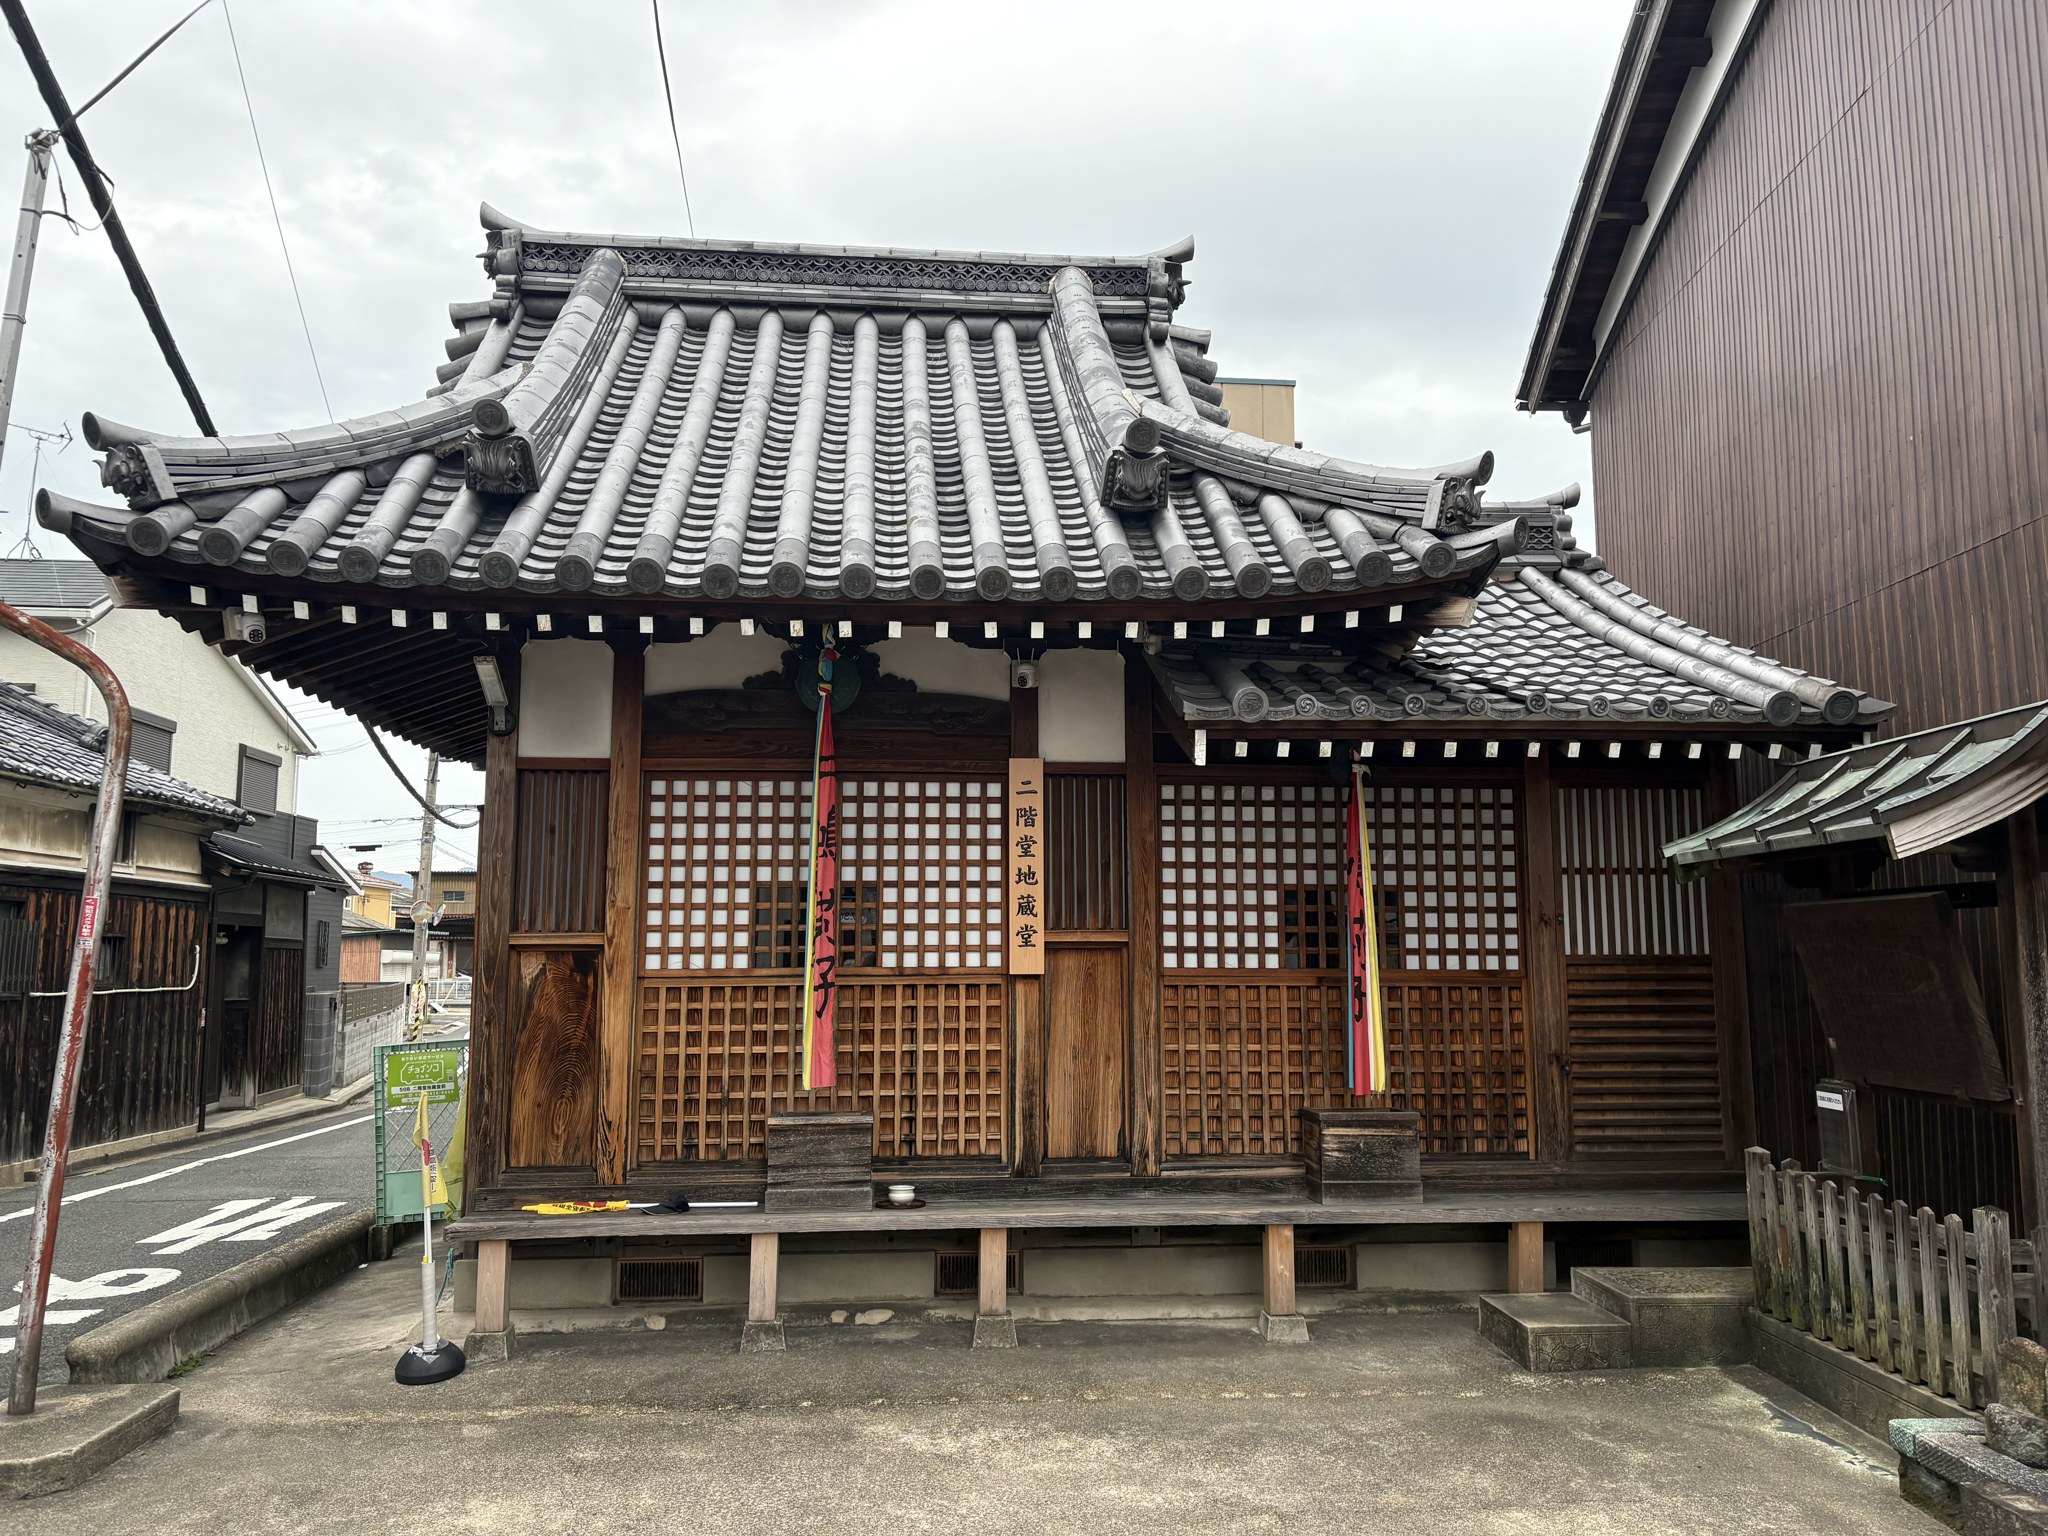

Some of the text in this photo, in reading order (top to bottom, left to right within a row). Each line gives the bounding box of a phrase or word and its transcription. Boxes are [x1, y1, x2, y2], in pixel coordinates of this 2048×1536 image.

[1014, 779, 1039, 948] 二階堂地蔵堂
[407, 1063, 440, 1074] チョイソコ
